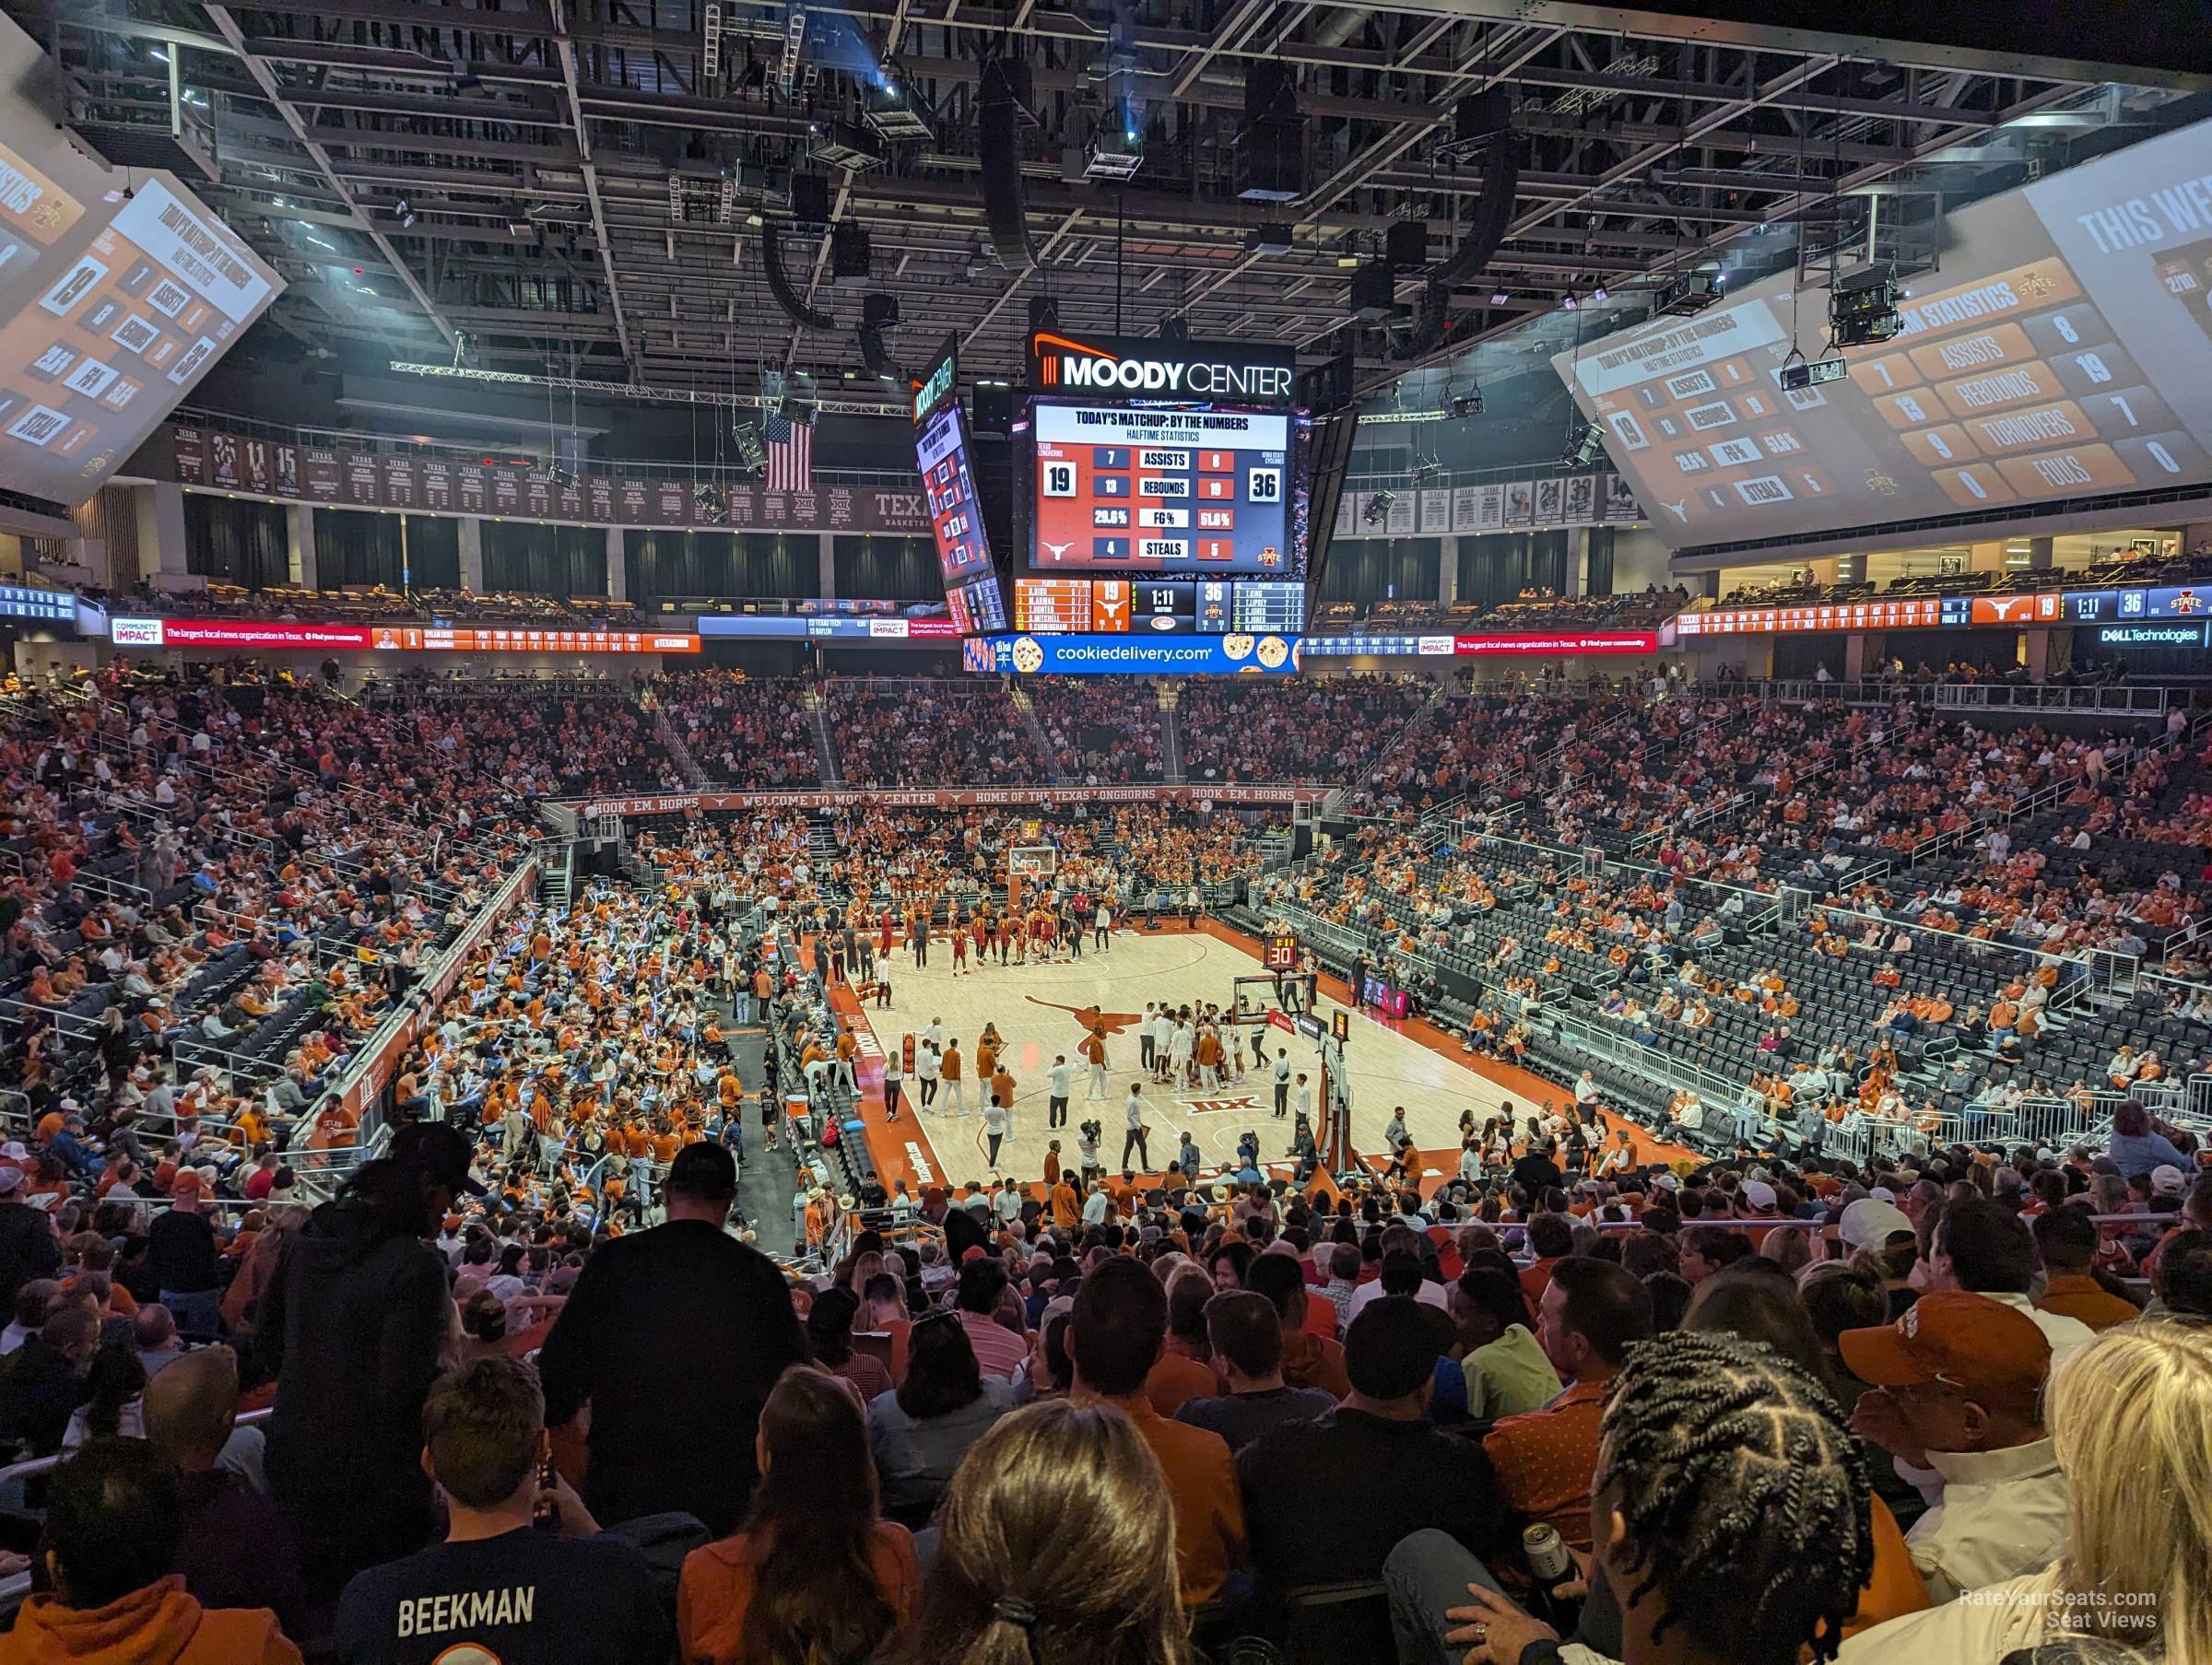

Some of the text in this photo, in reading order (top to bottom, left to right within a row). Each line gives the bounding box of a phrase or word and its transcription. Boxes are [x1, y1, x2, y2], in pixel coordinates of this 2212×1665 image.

[2077, 198, 2163, 254] THIS
[1922, 281, 2019, 327] STATISTICS
[2053, 316, 2079, 343] 8
[1597, 348, 1632, 370] TODAY'S
[1628, 336, 1669, 364] MATCHUP:
[1693, 313, 1737, 343] NUMBERS
[1938, 335, 2005, 369] ASSISTS
[1064, 357, 1292, 396] MOODY CENTER
[1873, 363, 1894, 387] 7
[2075, 353, 2112, 383] 19
[1670, 373, 1711, 396] ASSISTS
[1955, 370, 2041, 407] REBOUNDS
[1895, 395, 1927, 422] 13
[2110, 396, 2138, 427] 7
[1076, 411, 1249, 430] TODAY'S MATCHUP: BY THE NUMBERS
[1979, 409, 2076, 447] TURNOVERS
[1126, 428, 1200, 442] HALFTIME STATISTICS
[1615, 416, 1641, 446] 19
[1927, 433, 1953, 459] 9
[277, 447, 296, 474] 15
[1108, 451, 1115, 465] 7
[1144, 452, 1185, 466] ASSISTS
[1212, 453, 1220, 468] 8
[2147, 441, 2181, 473] 0
[1049, 466, 1070, 492] 19
[2032, 455, 2092, 487] FOULS
[1144, 481, 1185, 495] REBOUNDS
[1209, 482, 1222, 497] 19
[1253, 474, 1277, 498] 36
[1743, 480, 1784, 503] STEALS
[1959, 471, 1987, 498] 0
[875, 494, 929, 517] TEX
[1107, 541, 1115, 556] 4
[1147, 543, 1182, 556] STEALS
[1210, 543, 1219, 557] 5
[1103, 581, 1119, 601] 19
[1152, 589, 1174, 605] 1:11
[1205, 582, 1223, 602] 36
[2041, 597, 2053, 616] 19
[2077, 597, 2100, 613] 1:11
[2124, 593, 2141, 613] 36
[1680, 615, 1700, 625] TEXAS
[1941, 614, 1958, 625] FOULS
[116, 630, 158, 641] IMPACT
[166, 628, 181, 638] The
[181, 628, 204, 639] largest
[205, 629, 220, 639] local
[239, 631, 277, 641] organization
[278, 632, 285, 640] in
[285, 632, 303, 640] Texas.
[2101, 627, 2197, 642] DELL Technologies
[1056, 645, 1209, 662] cookiedelivery.com
[1420, 645, 1451, 653] IMPACT
[1467, 641, 1486, 651] largest
[1515, 641, 1552, 651] organization
[741, 793, 936, 807] WELCOME TO MOOY CENTER
[975, 789, 1156, 803] HOME OF THE TEXAS LONGHORNS
[1191, 788, 1223, 799] HOOK
[1253, 790, 1295, 801] HORNS
[594, 802, 627, 814] HOOK
[659, 797, 699, 811] HORNS
[1024, 827, 1036, 838] 30
[1271, 947, 1290, 965] 30
[397, 1586, 535, 1638] BEEKMAN
